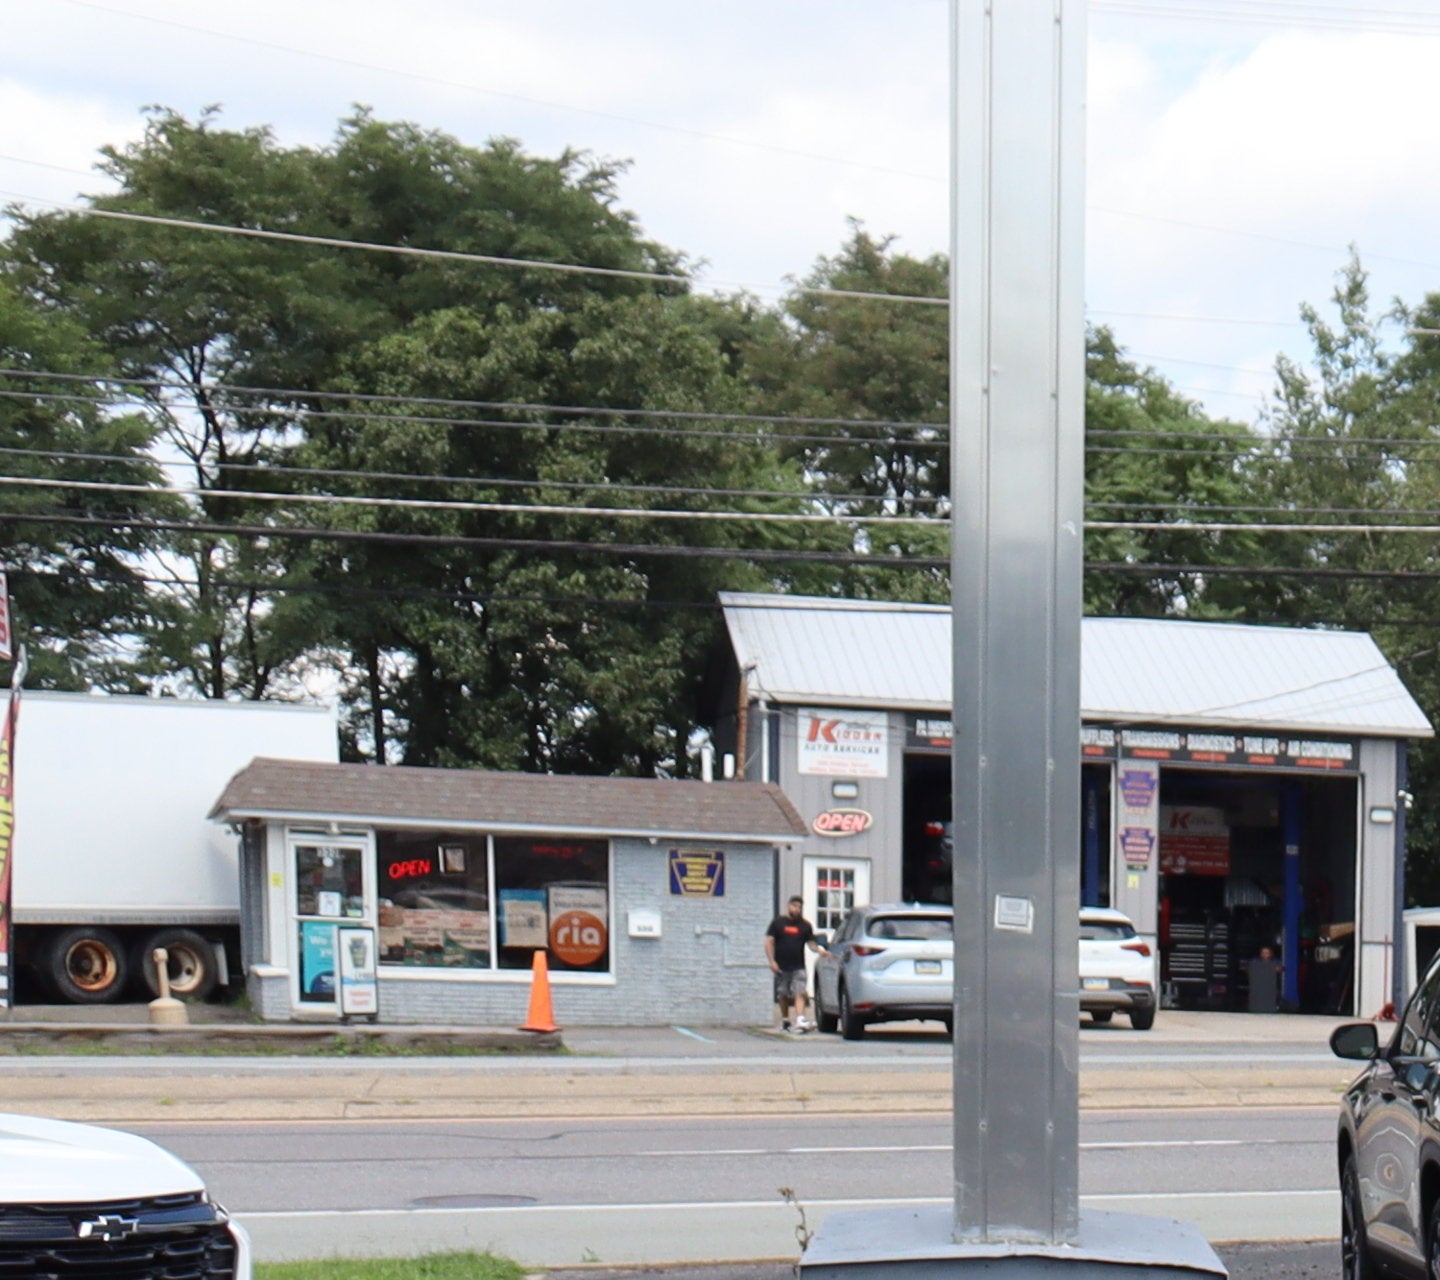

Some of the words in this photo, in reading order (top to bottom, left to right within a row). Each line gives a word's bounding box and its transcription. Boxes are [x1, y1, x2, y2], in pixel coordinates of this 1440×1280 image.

[816, 812, 866, 832] OPEN
[388, 859, 433, 879] OPEN
[556, 917, 600, 945] ria
